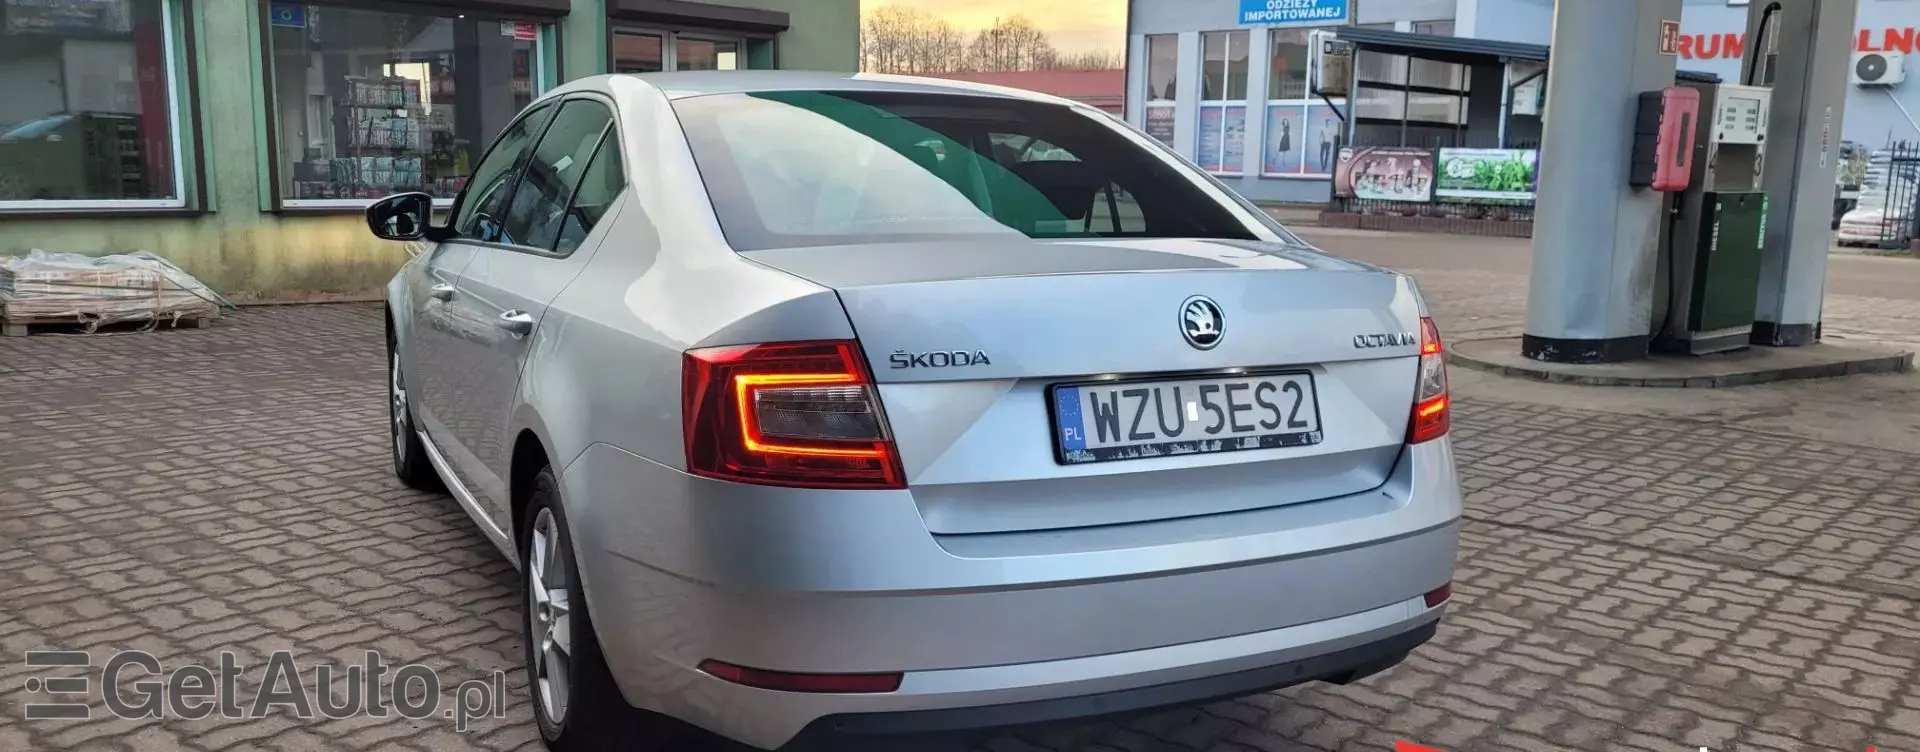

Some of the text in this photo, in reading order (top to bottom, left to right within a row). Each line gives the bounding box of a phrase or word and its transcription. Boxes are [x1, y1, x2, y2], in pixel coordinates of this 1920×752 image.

[1244, 7, 1341, 22] IMPORTOWANEJ
[1710, 220, 1720, 251] DIESEL
[1353, 332, 1416, 349] OCTAVIA
[889, 348, 992, 369] ŠKODA
[1089, 380, 1308, 443] WZU 5ES2
[1064, 427, 1082, 441] PL
